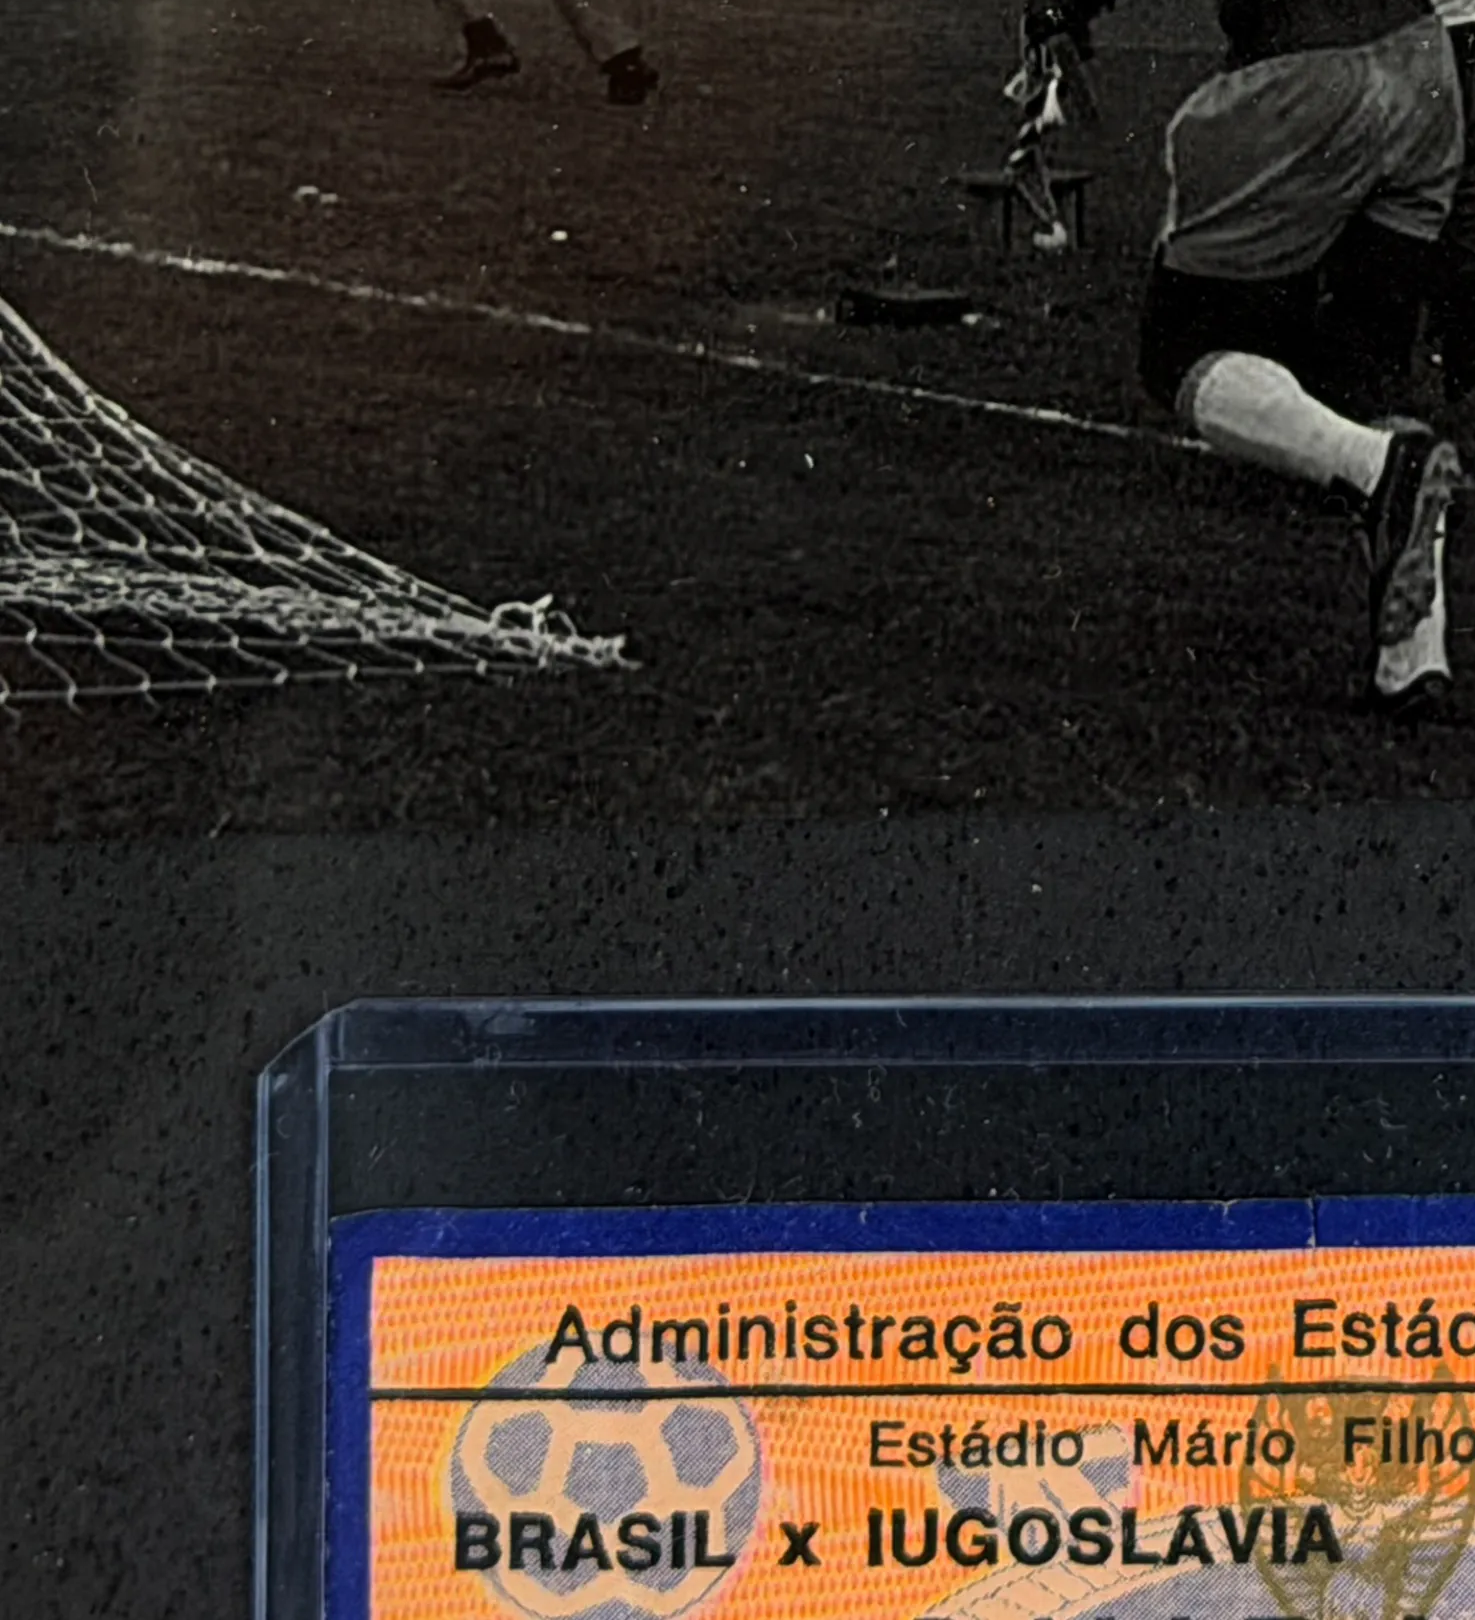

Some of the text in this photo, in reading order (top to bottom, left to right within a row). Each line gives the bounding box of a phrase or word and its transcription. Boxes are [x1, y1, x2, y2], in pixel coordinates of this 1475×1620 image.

[546, 1302, 1073, 1374] Administração
[1118, 1301, 1247, 1362] dos
[870, 1418, 1085, 1470] Estádio
[1133, 1416, 1302, 1468] Mário
[454, 1506, 1342, 1571] BRASIL x IUGOSLÁVIA
